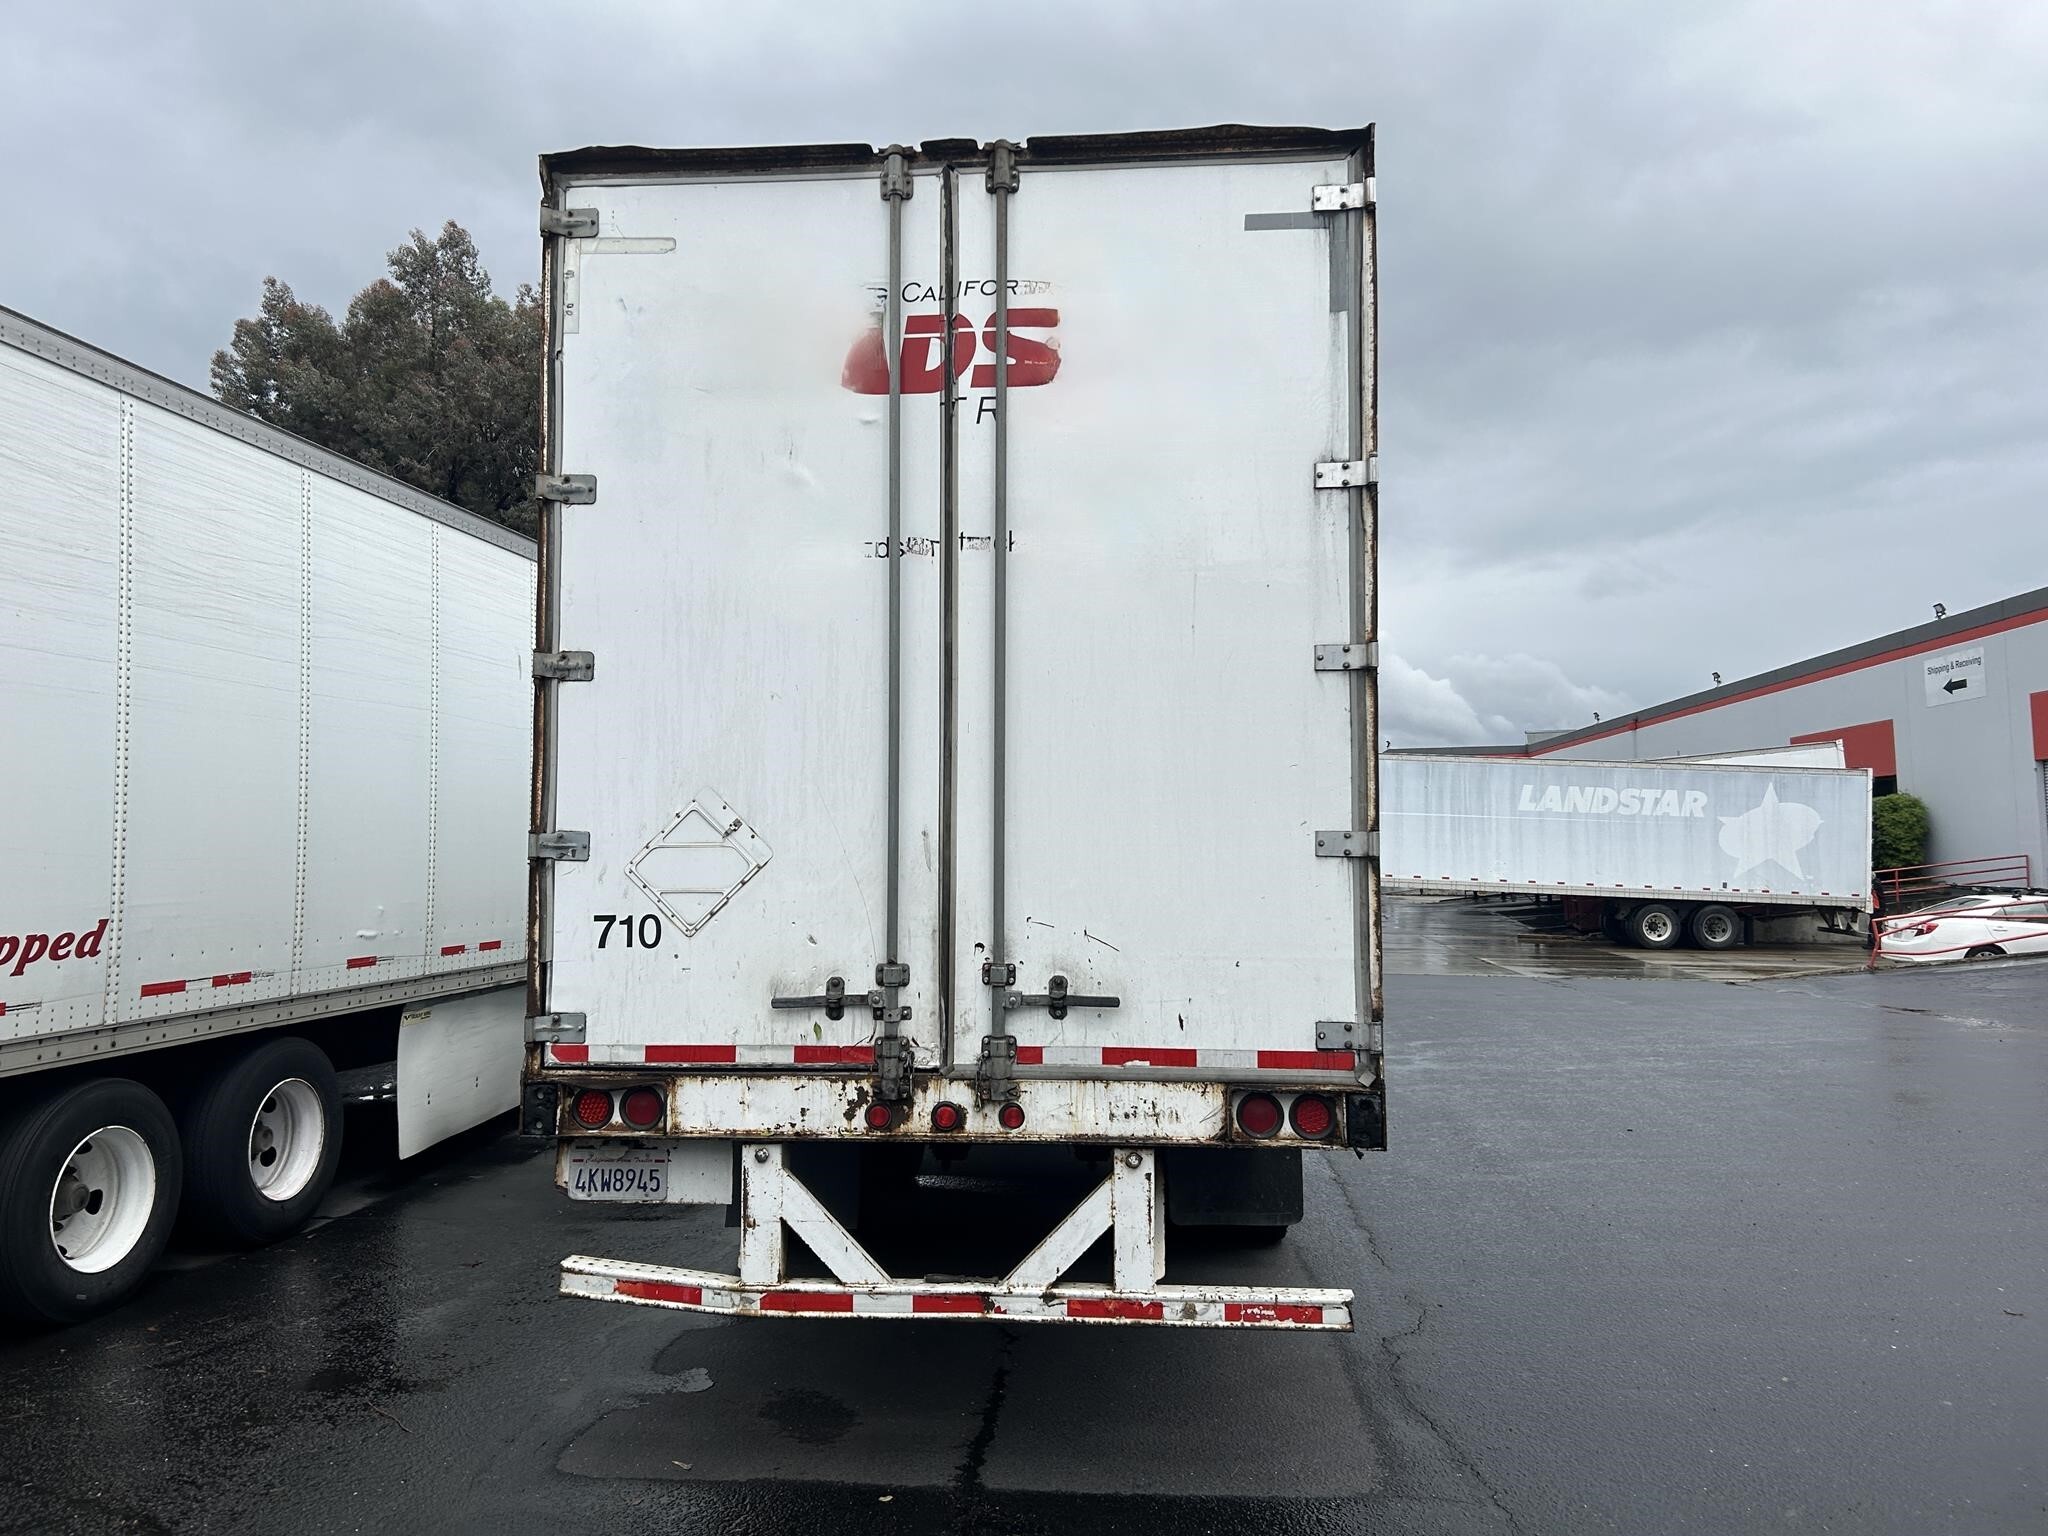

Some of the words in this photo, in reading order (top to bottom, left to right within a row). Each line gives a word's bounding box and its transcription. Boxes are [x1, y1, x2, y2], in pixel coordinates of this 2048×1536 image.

[1927, 664, 1949, 675] Shipping
[1955, 656, 1981, 668] Receiving
[1518, 784, 1708, 817] LANDSTAR
[593, 914, 662, 948] 710
[575, 1168, 660, 1192] 4KW8945
